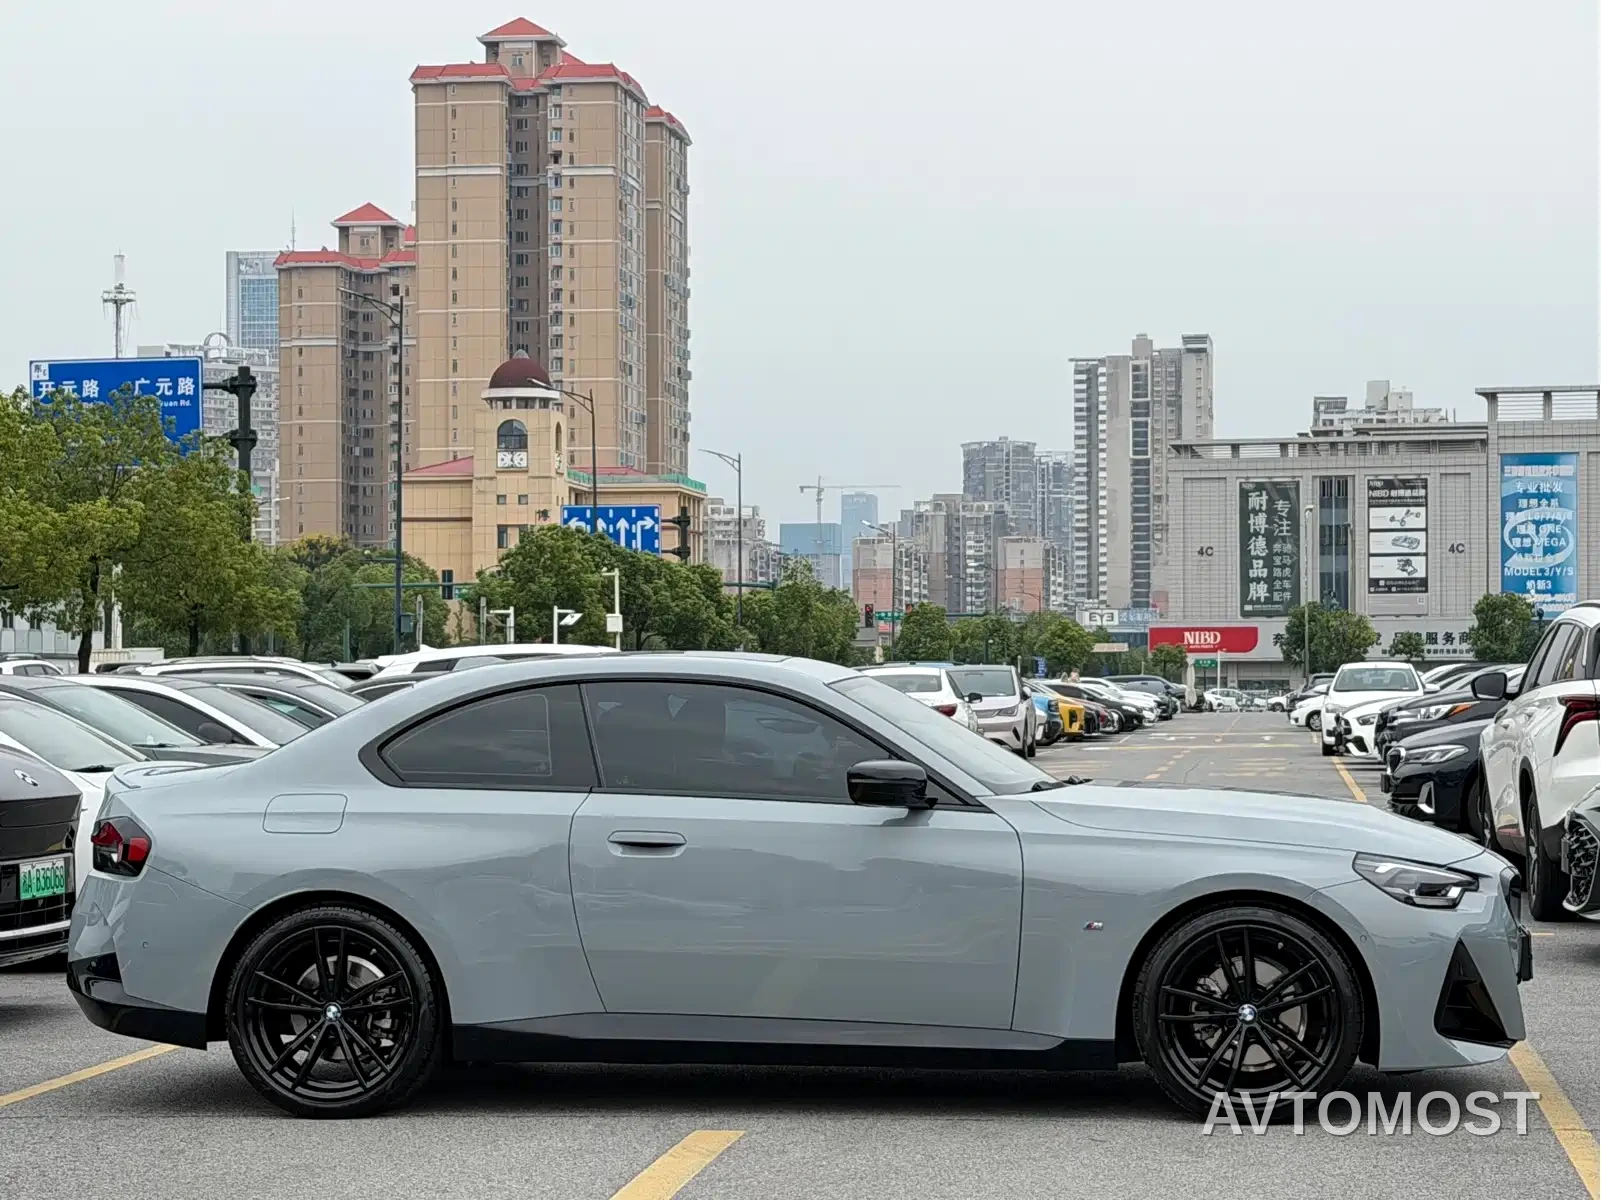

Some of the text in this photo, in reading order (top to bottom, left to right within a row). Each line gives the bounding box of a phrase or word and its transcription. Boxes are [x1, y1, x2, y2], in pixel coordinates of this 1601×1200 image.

[38, 377, 195, 399] 开元路 广元路
[1516, 481, 1563, 494] 专业批发
[1273, 499, 1292, 537] 专注
[1197, 545, 1214, 557] 4C
[1247, 490, 1269, 603] 耐博德品牌
[1448, 542, 1465, 554] 4C
[1504, 566, 1574, 577] MODEL 3/Y/S
[1183, 631, 1221, 645] NIBD
